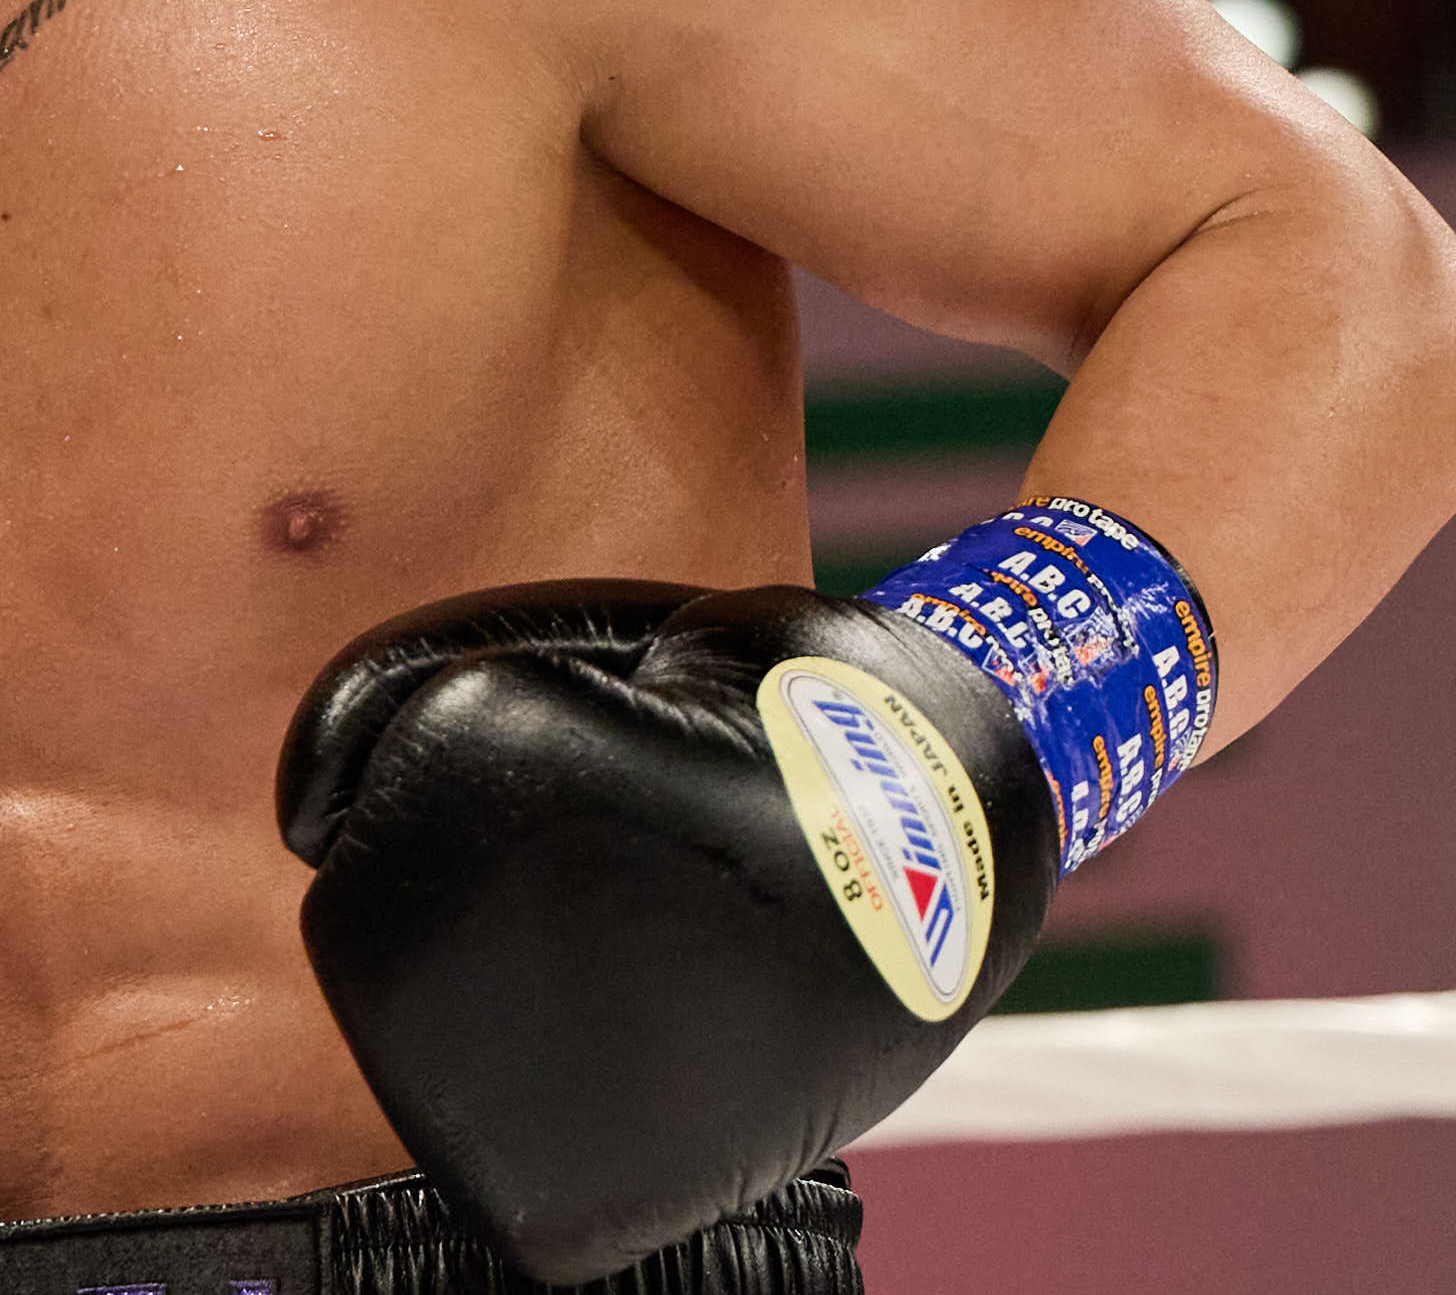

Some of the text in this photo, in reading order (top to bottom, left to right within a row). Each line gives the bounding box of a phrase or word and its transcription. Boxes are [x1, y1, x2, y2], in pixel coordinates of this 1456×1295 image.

[997, 550, 1092, 620] A.B.C
[1174, 599, 1214, 688] empire
[1151, 644, 1192, 741] A.B.C
[811, 699, 956, 969] Winning
[883, 693, 990, 903] Made in JAPAN
[842, 878, 864, 903] 8
